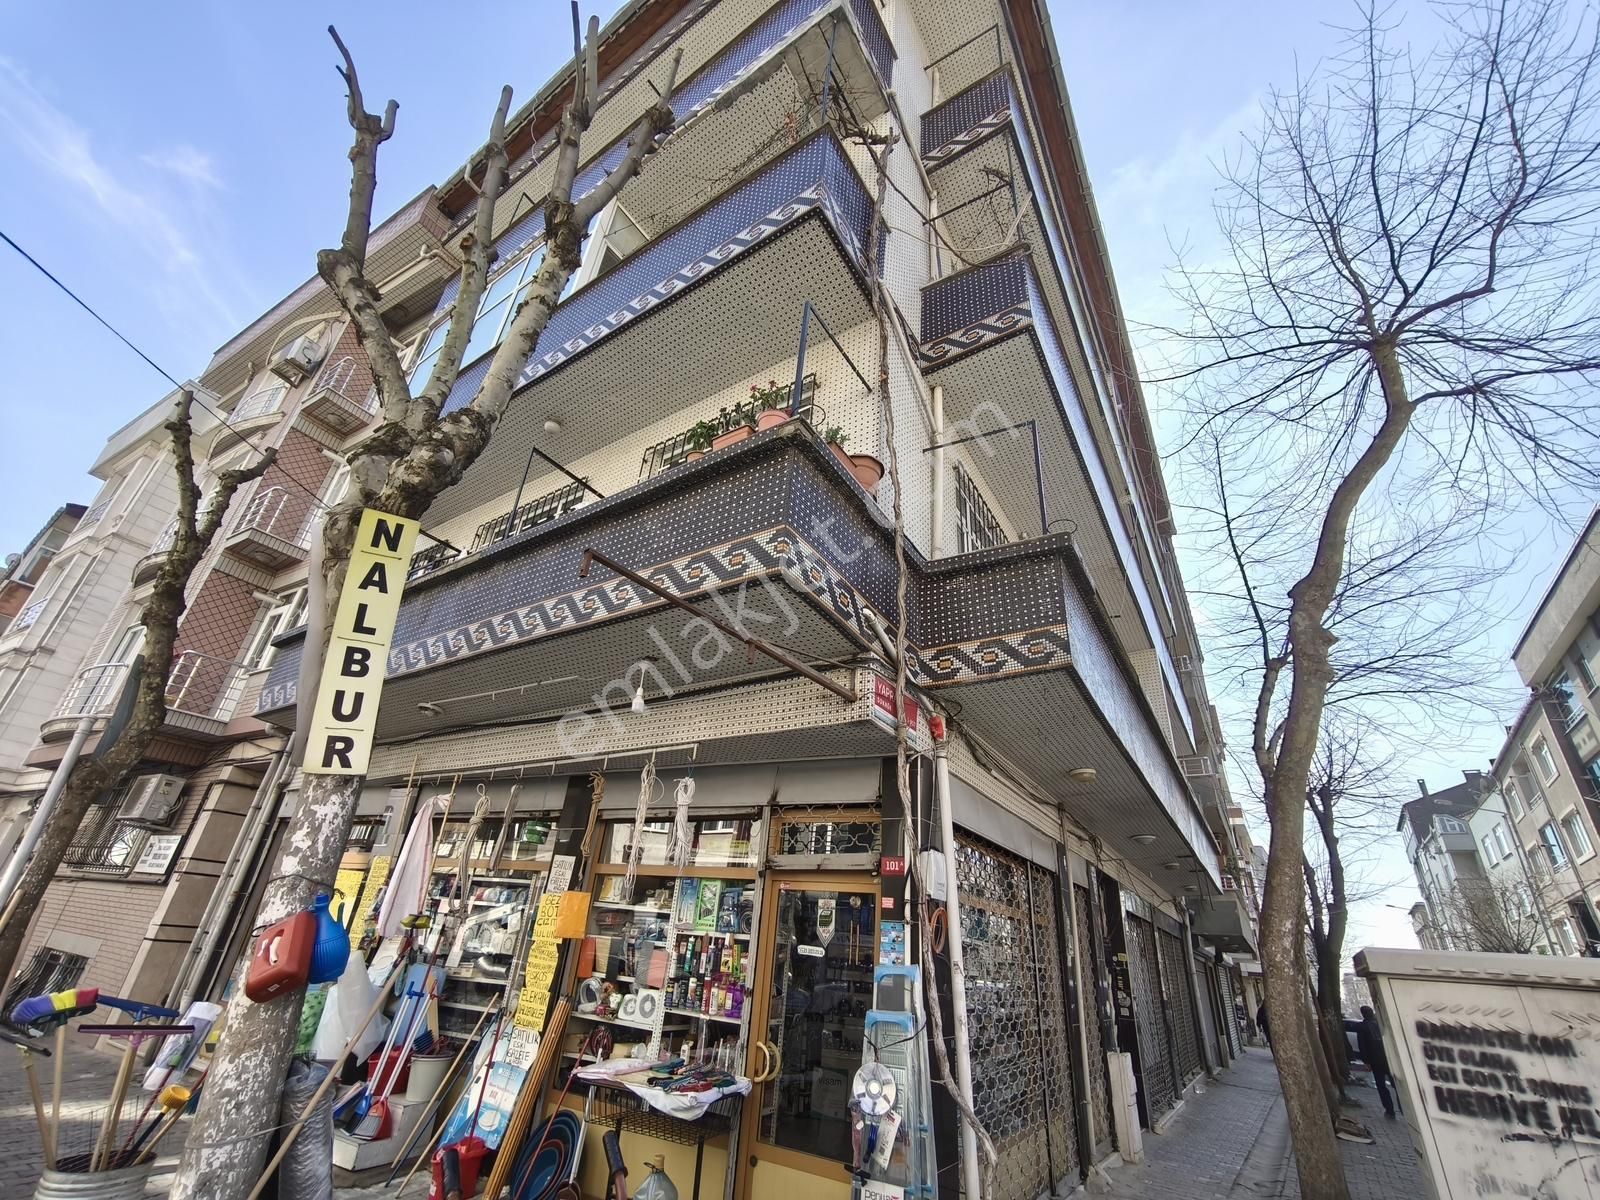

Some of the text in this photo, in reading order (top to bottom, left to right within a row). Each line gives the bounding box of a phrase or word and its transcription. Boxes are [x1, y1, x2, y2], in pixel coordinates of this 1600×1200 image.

[321, 518, 404, 769] NALBUR
[877, 681, 897, 702] YAPR
[886, 861, 899, 870] 101
[1461, 1068, 1503, 1090] 500
